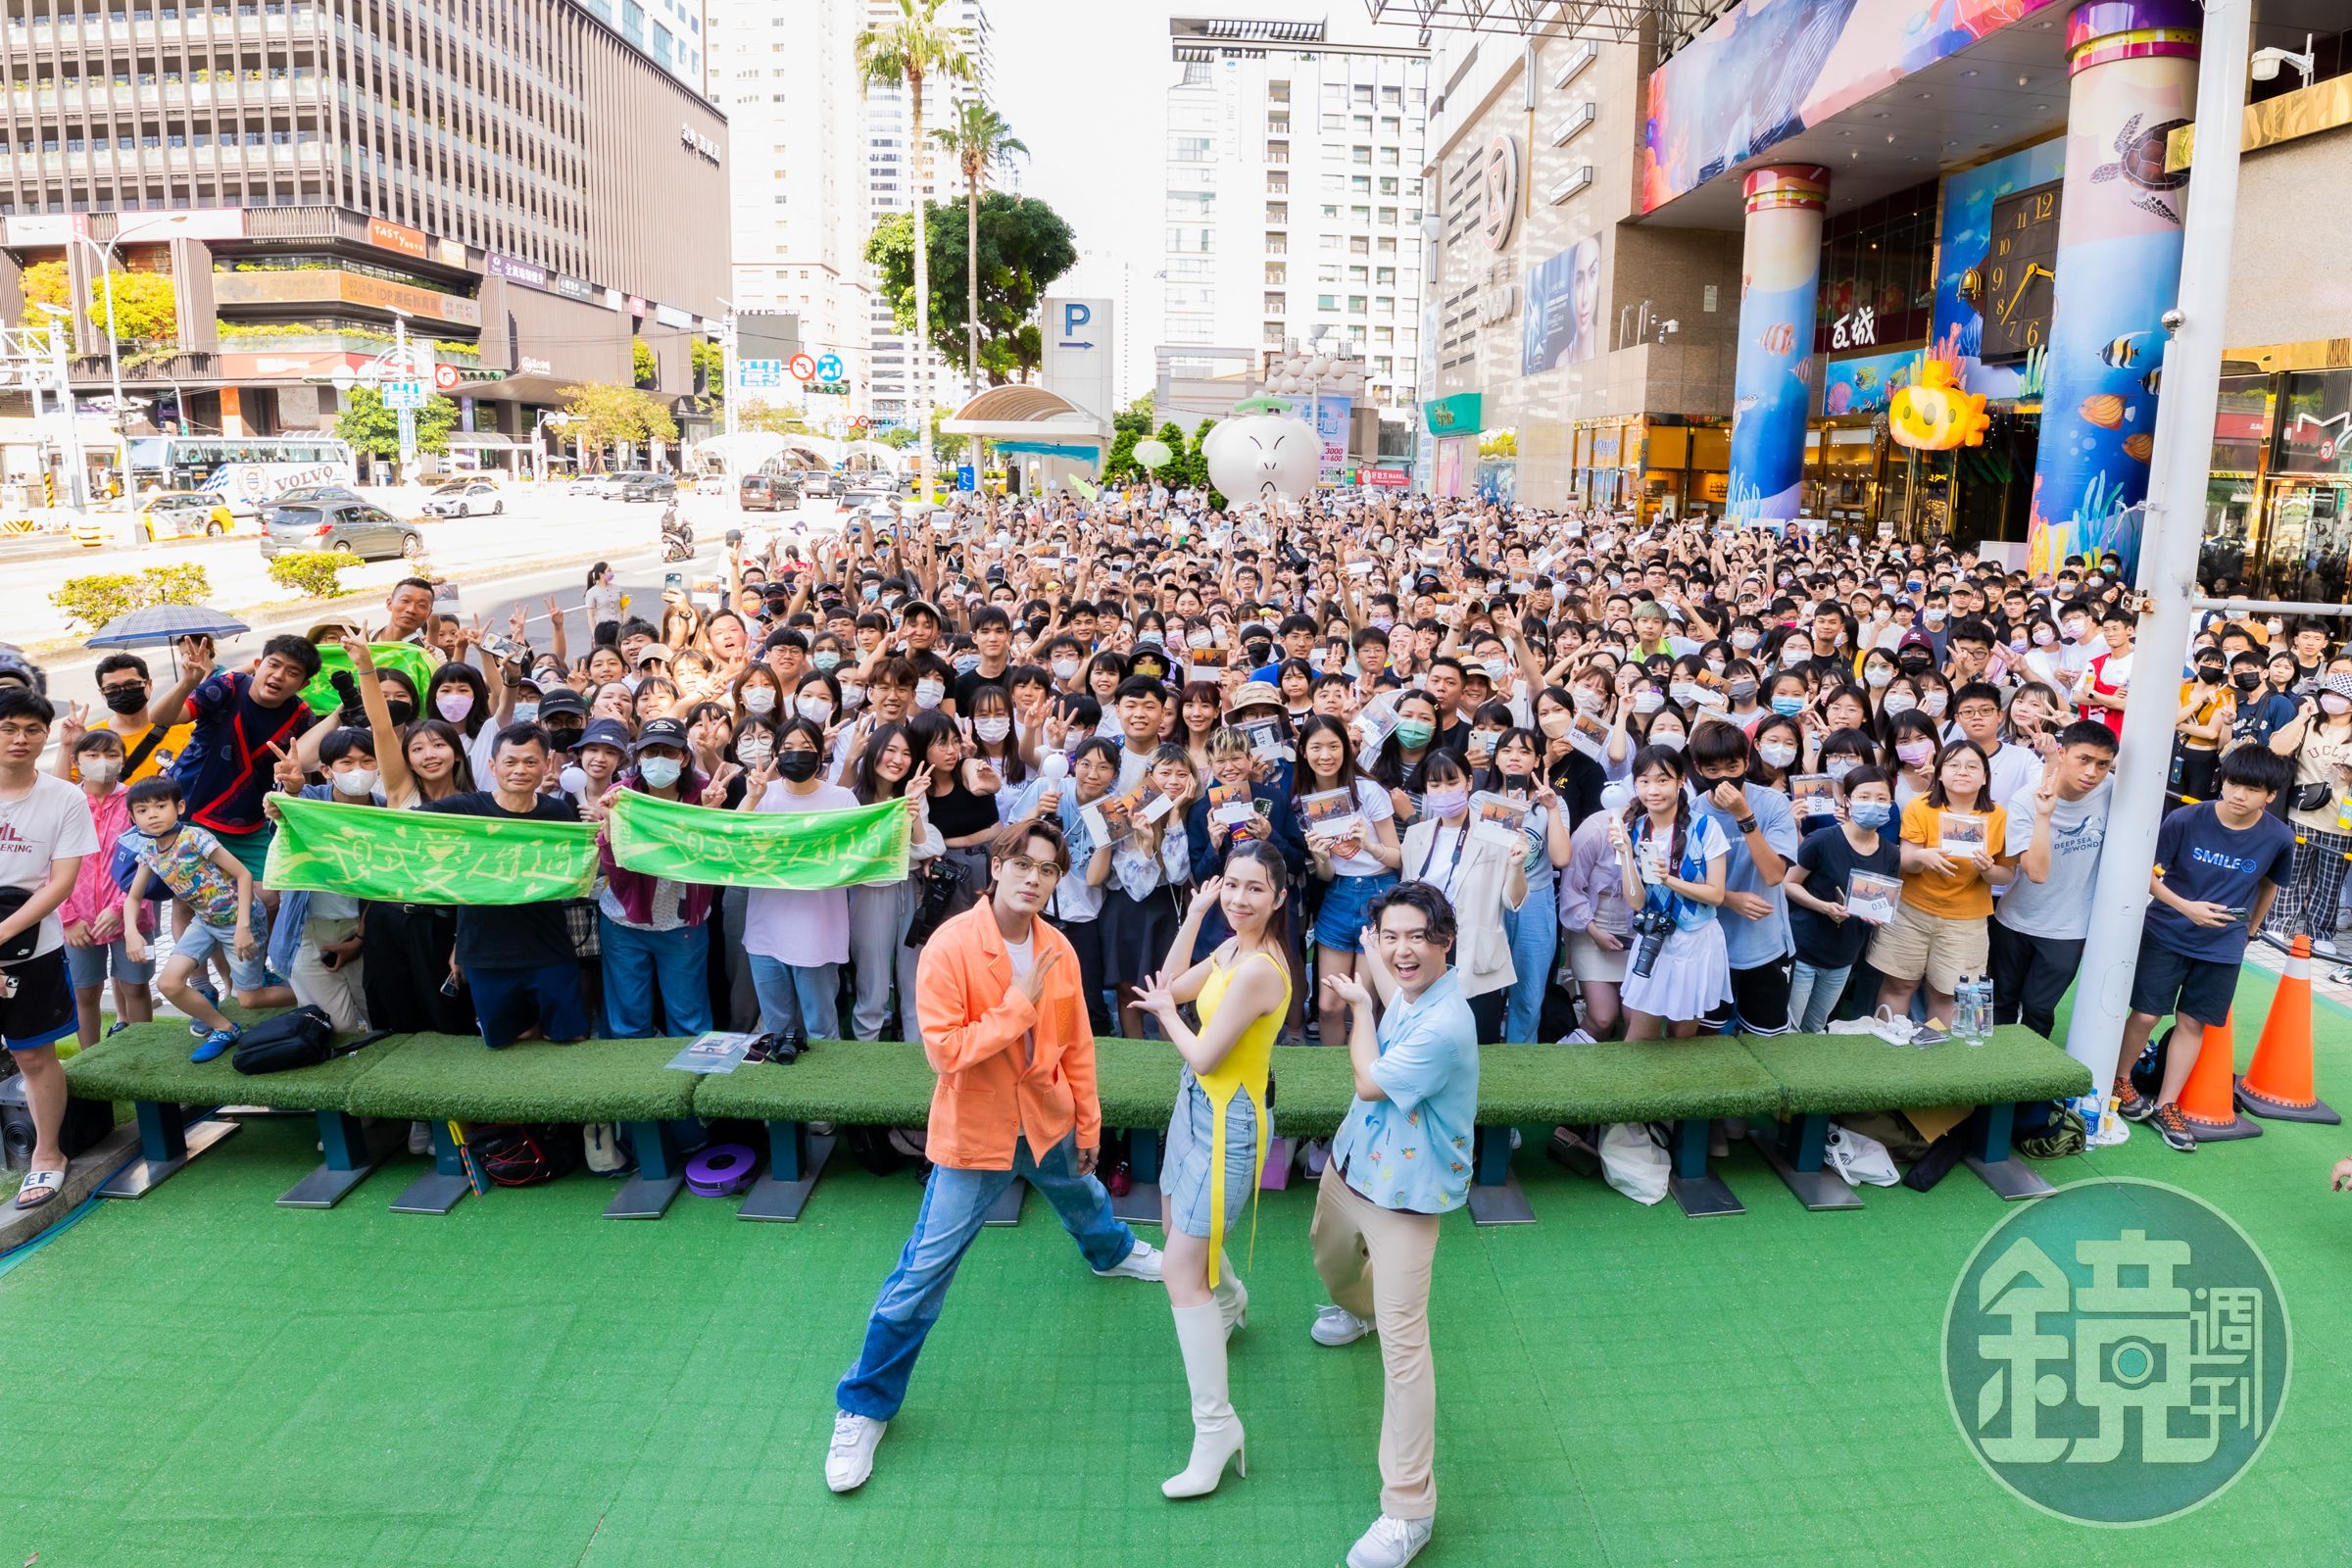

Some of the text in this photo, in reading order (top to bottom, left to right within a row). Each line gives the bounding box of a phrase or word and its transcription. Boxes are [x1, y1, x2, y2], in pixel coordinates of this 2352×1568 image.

[2035, 192, 2053, 220] 12
[2017, 211, 2027, 229] 11
[374, 225, 405, 247] TASTY
[1998, 237, 2010, 257] 10
[1992, 267, 2003, 292] 9
[1996, 298, 2004, 316] 8
[1065, 304, 1091, 336] P
[2009, 320, 2017, 337] 7
[2027, 320, 2038, 346] 6
[274, 466, 333, 491] VOLVO
[2307, 745, 2350, 764] UCLA
[2054, 840, 2075, 850] DEEP
[2192, 847, 2241, 870] SMILE
[1871, 901, 1887, 911] 033
